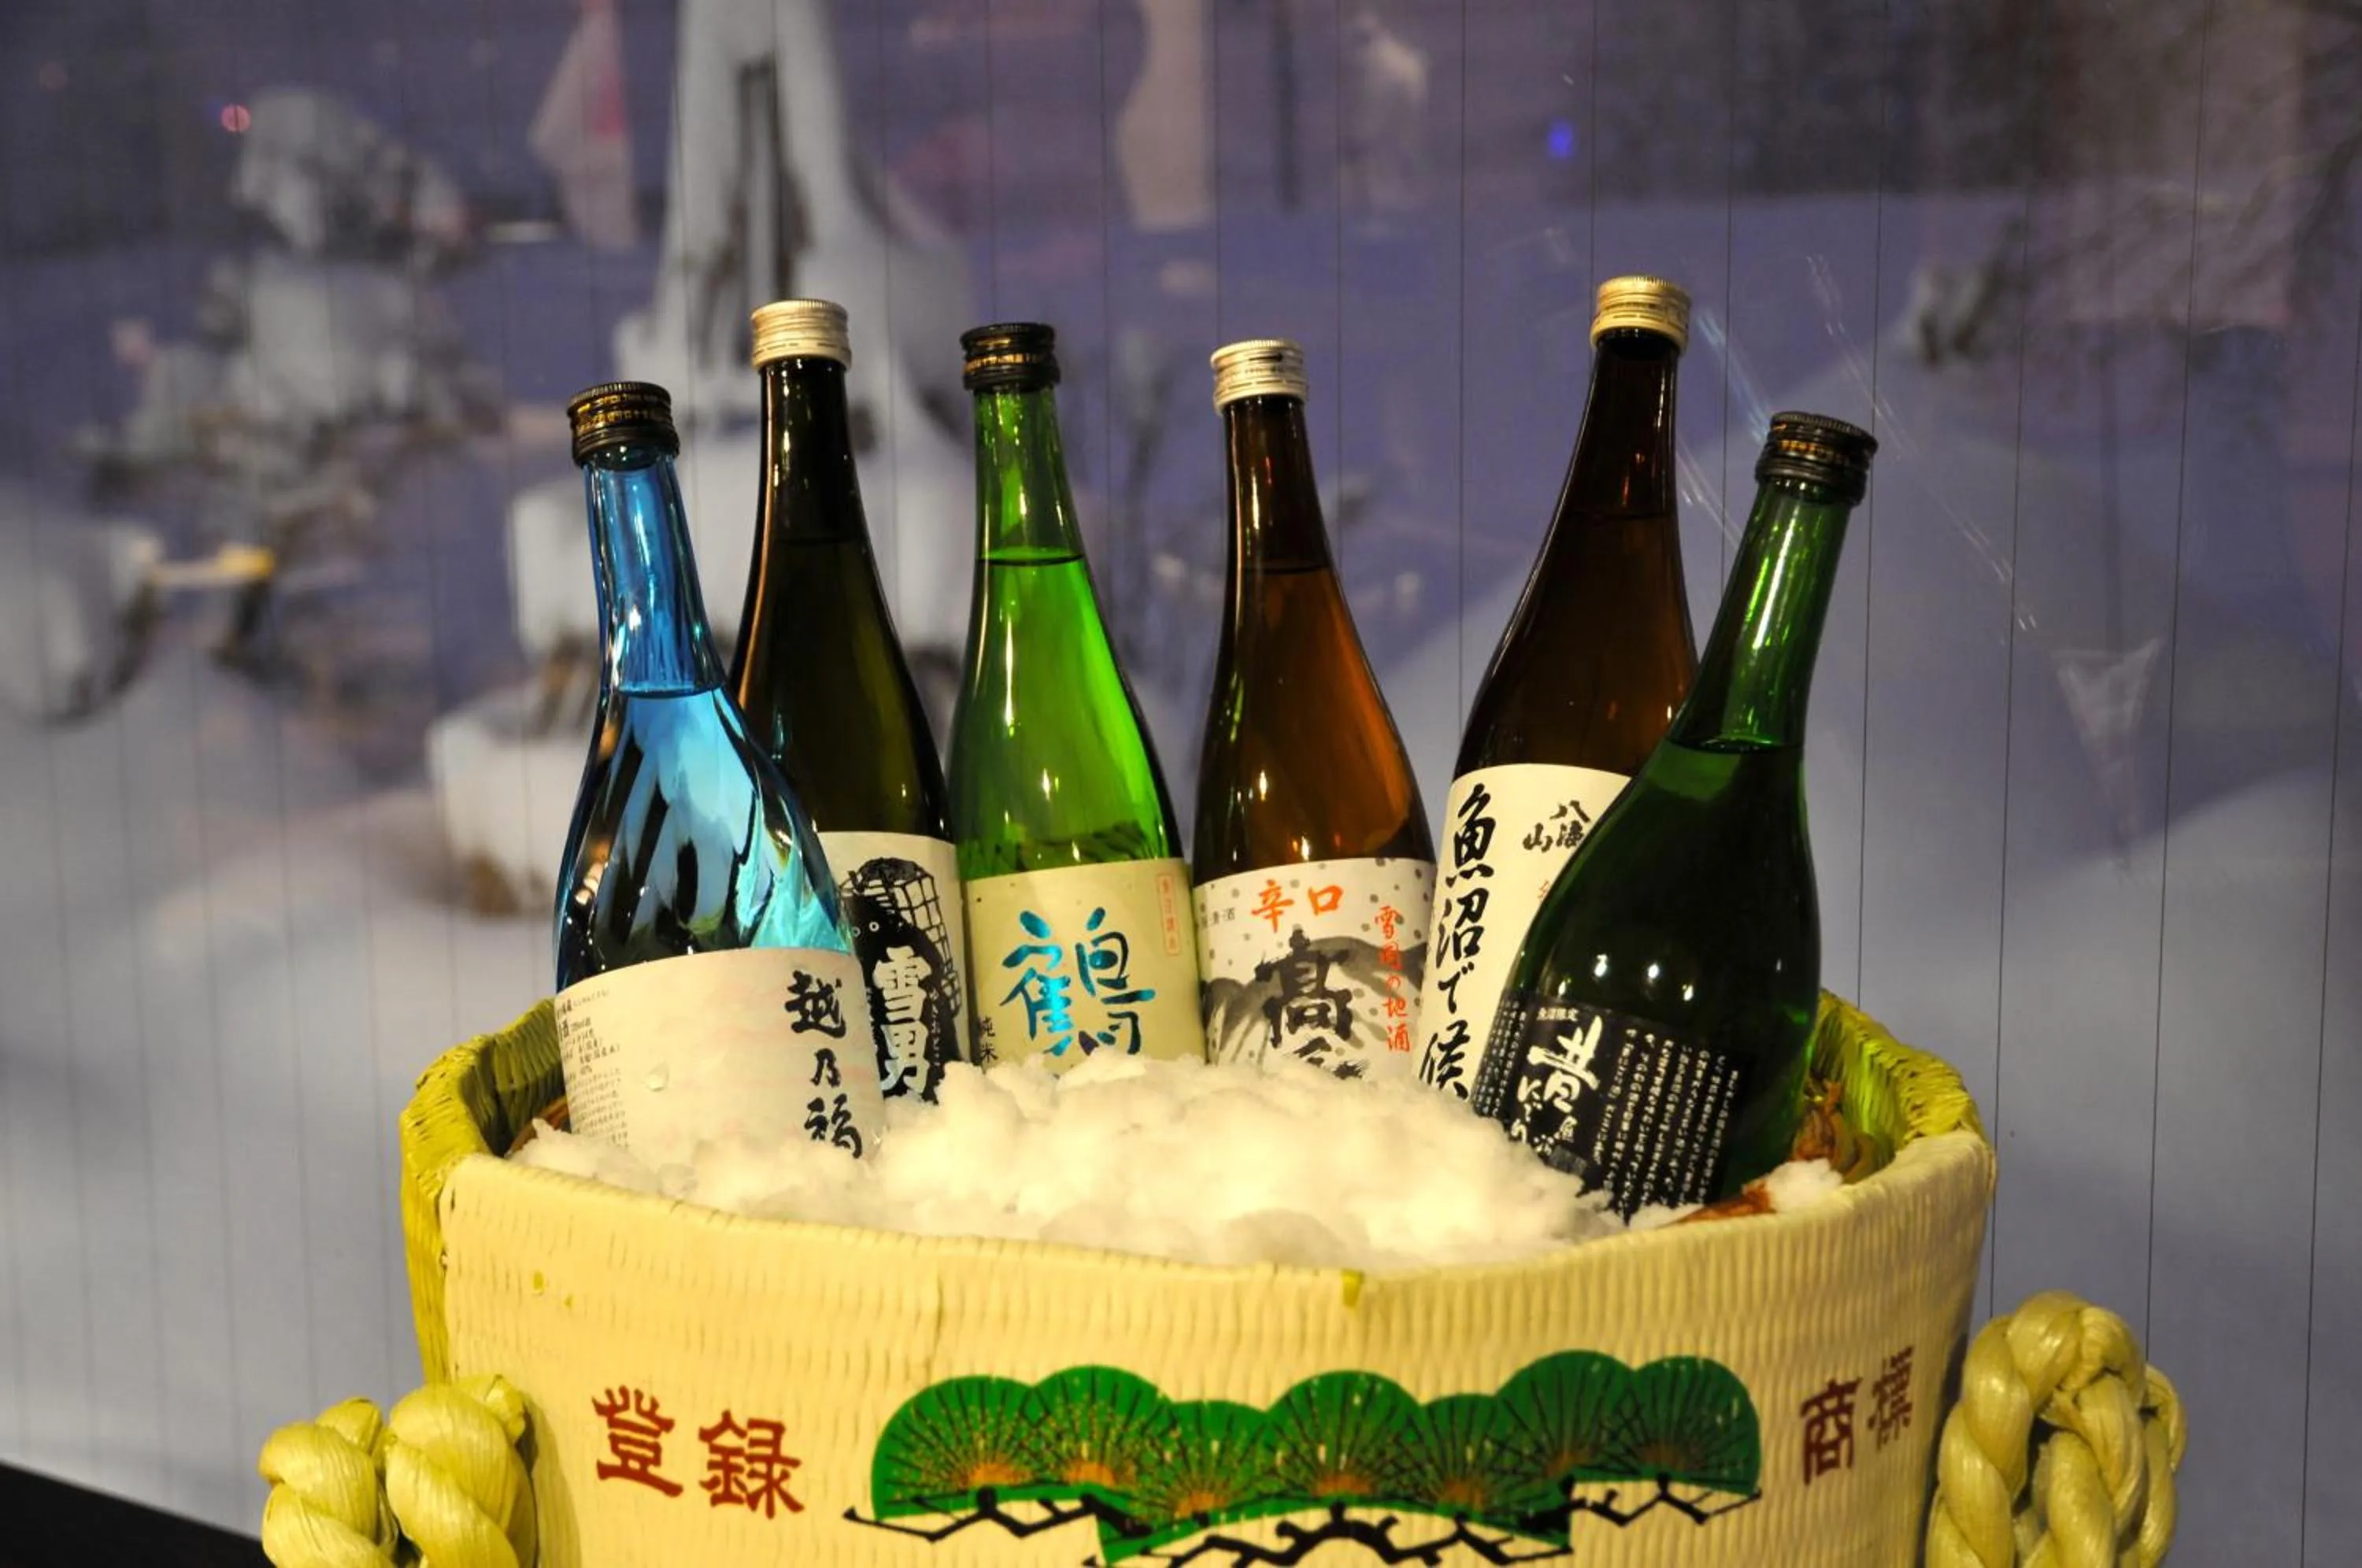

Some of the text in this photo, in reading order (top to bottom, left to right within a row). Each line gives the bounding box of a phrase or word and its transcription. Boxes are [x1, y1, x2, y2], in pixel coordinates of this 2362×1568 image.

[1251, 878, 1344, 934] 辛口
[872, 945, 933, 1094] 雪男
[591, 1385, 804, 1520] 登録
[1799, 1346, 1914, 1486] 商標
